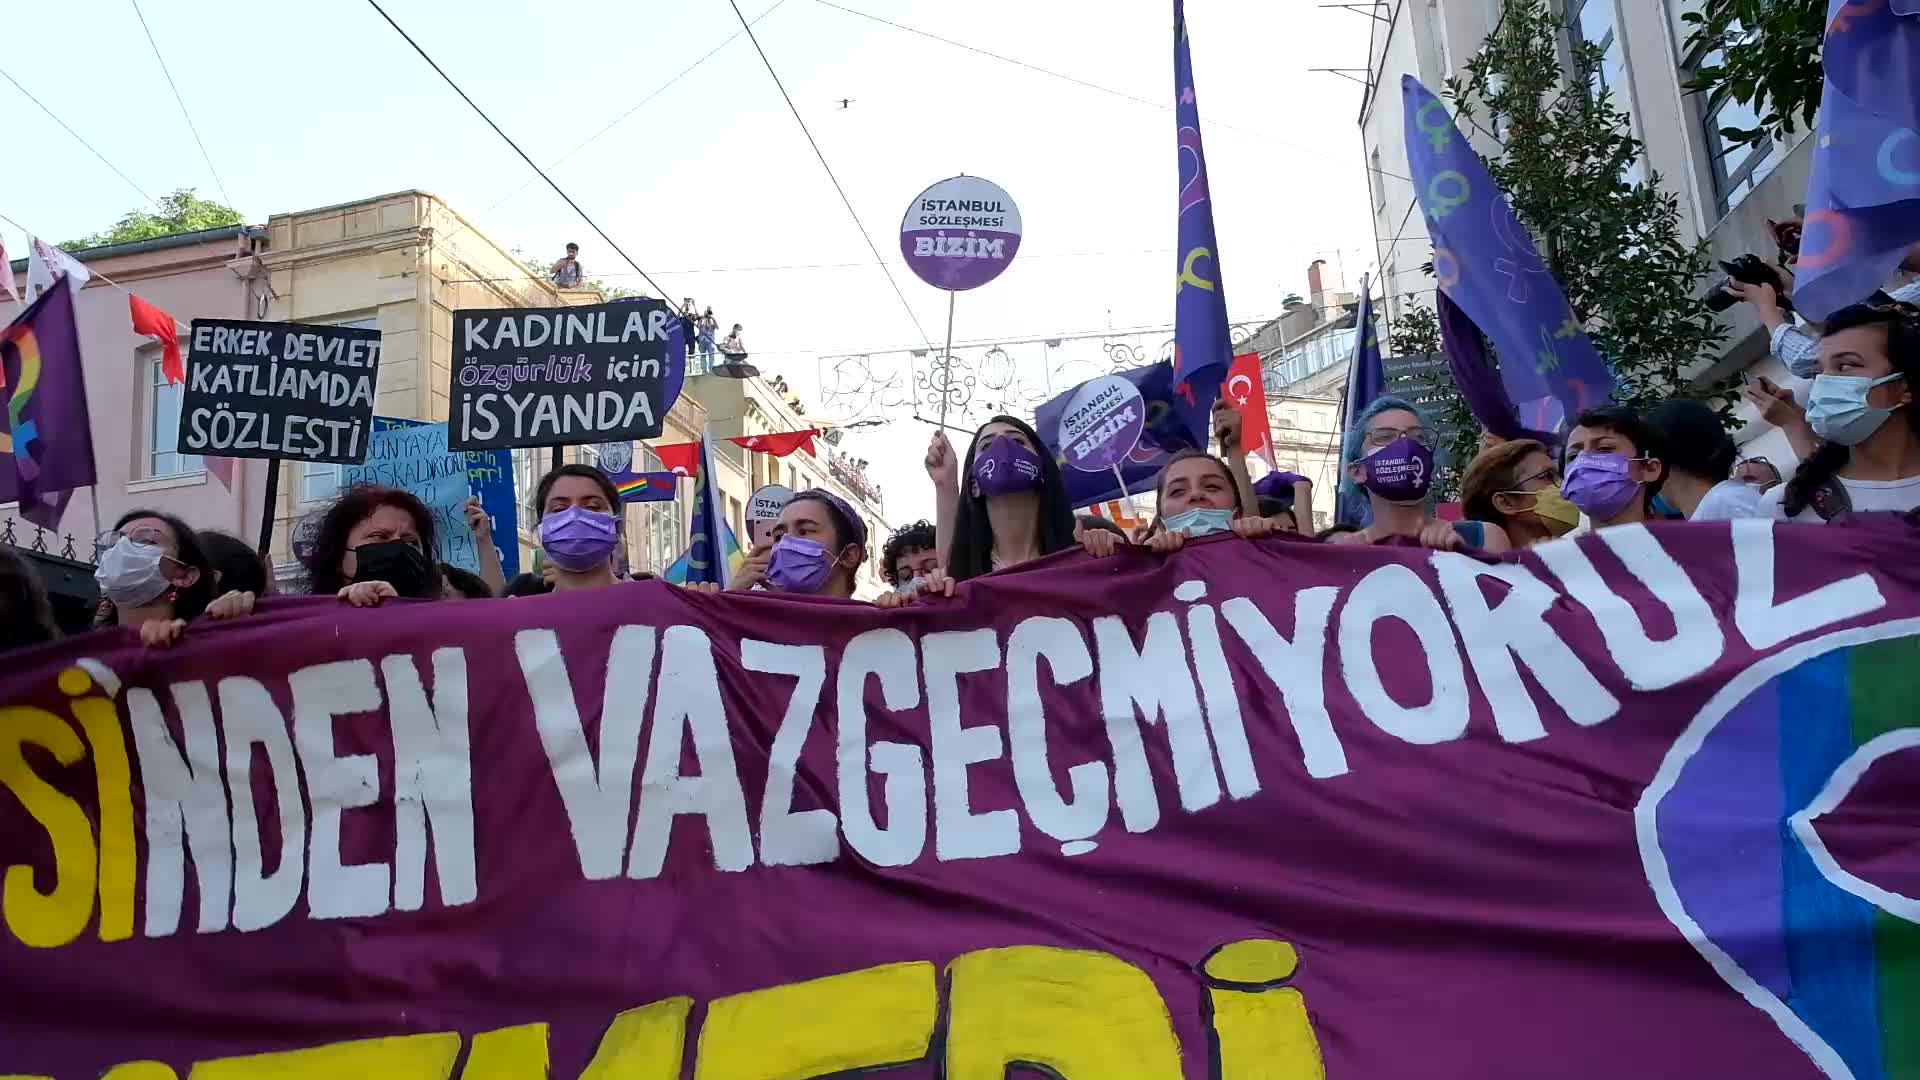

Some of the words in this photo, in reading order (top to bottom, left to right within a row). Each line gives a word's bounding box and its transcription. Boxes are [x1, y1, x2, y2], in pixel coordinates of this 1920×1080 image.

[919, 213, 1004, 228] SÖZLEŞMESİ
[921, 199, 1006, 213] İSTANBUL
[913, 230, 1005, 259] BİZİM
[194, 326, 273, 356] ERKEK
[283, 333, 381, 368] DEVLET
[464, 310, 669, 351] KADINLAR
[191, 355, 373, 407] KATLİAMDA
[459, 353, 592, 391] özgürlük
[606, 353, 660, 383] için
[461, 391, 655, 442] İSYANDA
[1063, 384, 1120, 429] İSTANBUL
[186, 402, 361, 458] SÖZLEŞTİ
[1073, 406, 1137, 460] BİZİM
[514, 518, 1888, 880] VAZGEÇMİYORUZ
